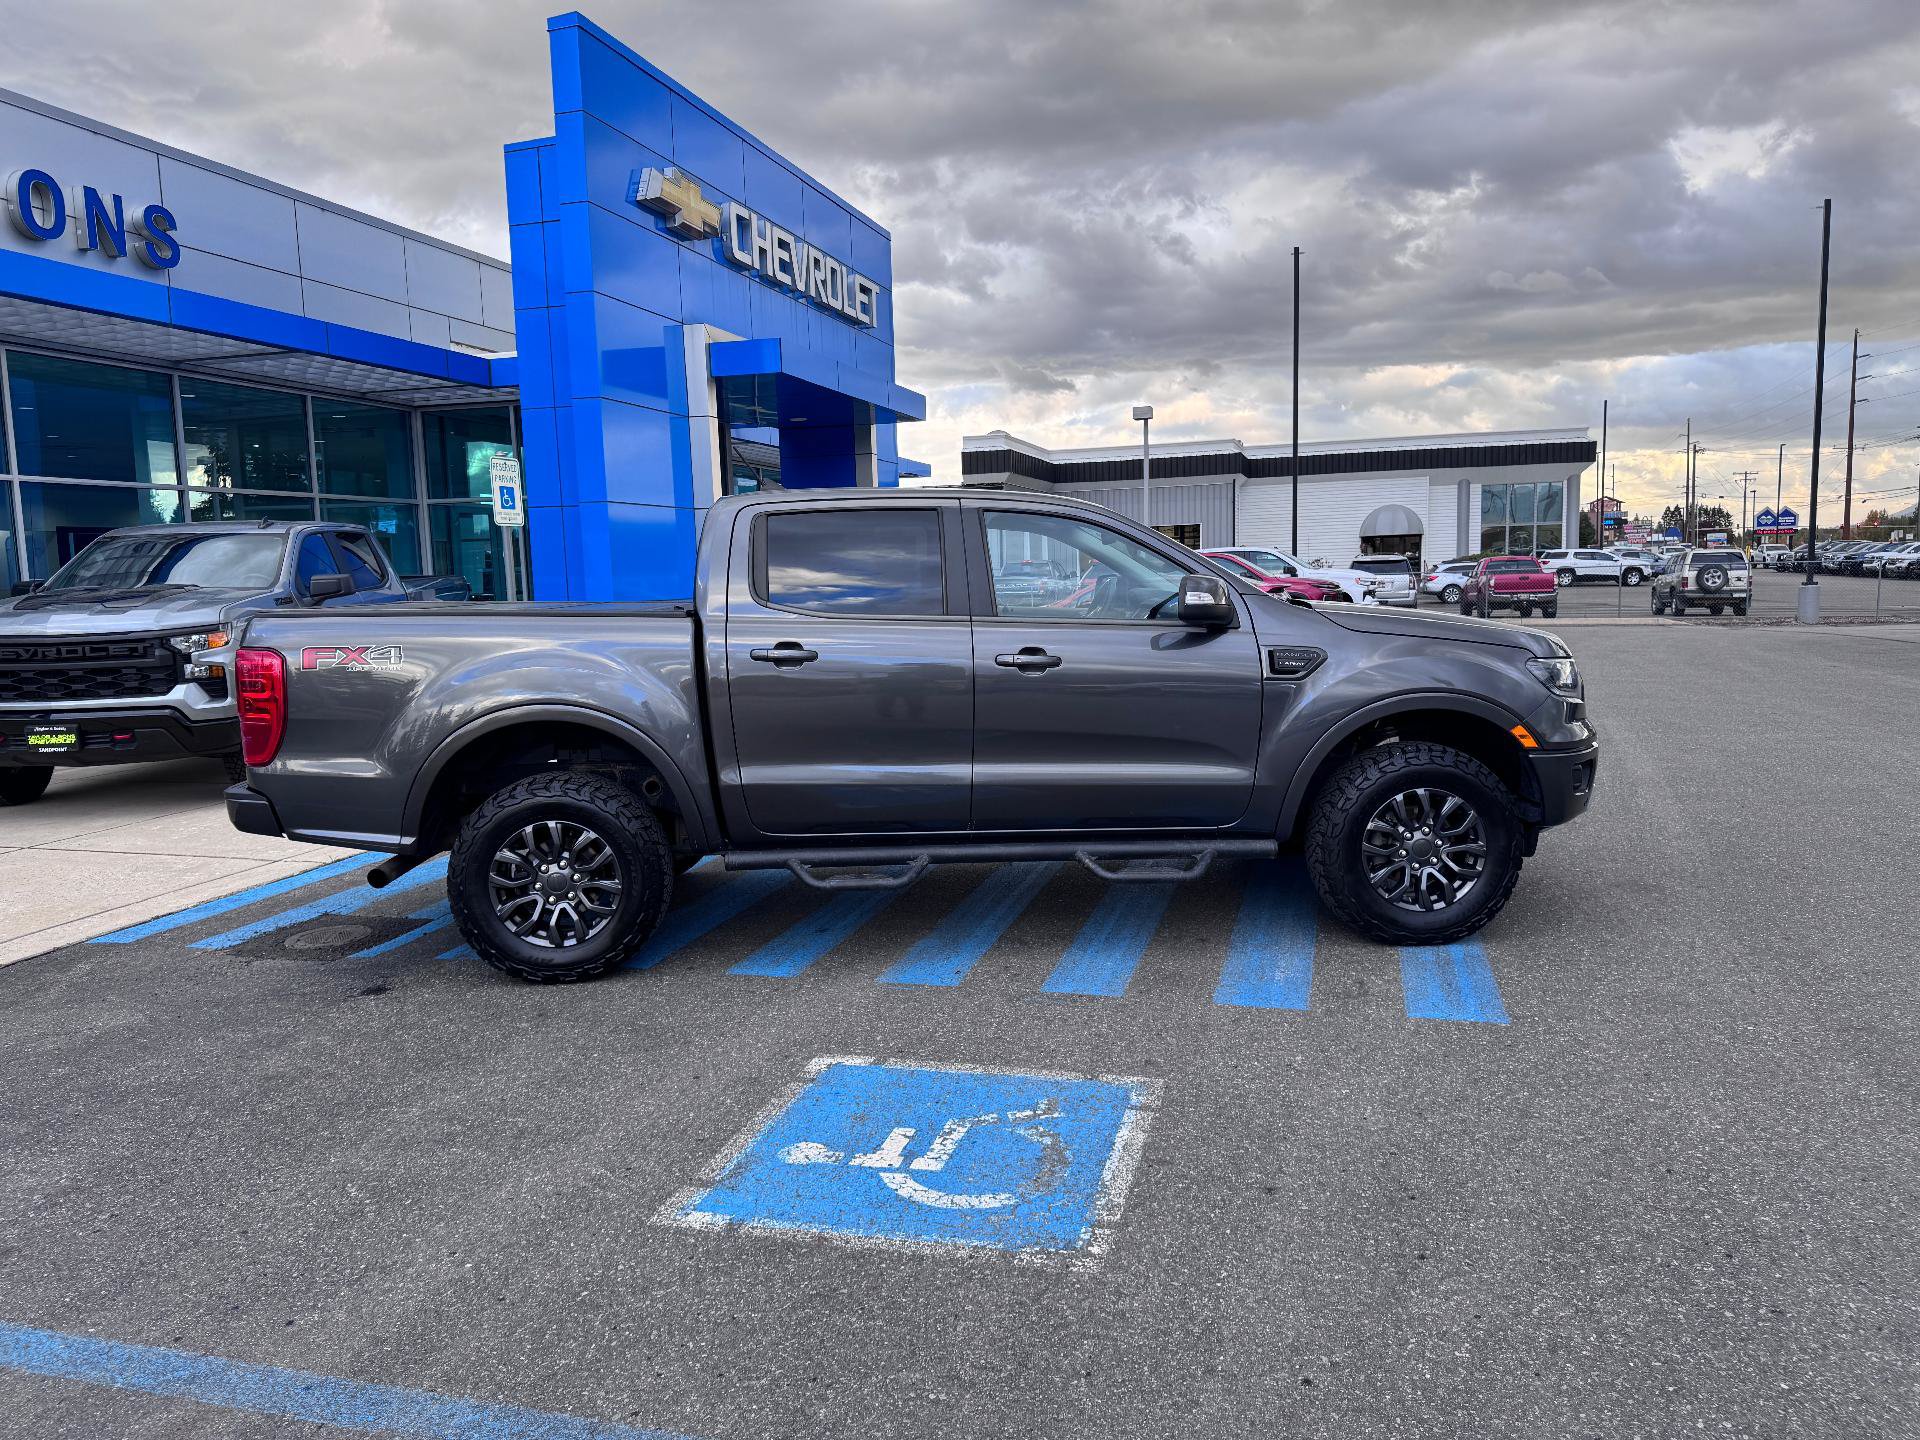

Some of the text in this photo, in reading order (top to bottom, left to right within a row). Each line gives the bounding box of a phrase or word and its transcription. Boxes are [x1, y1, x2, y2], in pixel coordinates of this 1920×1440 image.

[14, 168, 181, 269] ONS
[726, 201, 879, 328] CHEVROLET
[492, 462, 517, 473] RESERVED
[494, 474, 517, 485] PARKING
[301, 645, 403, 671] FX4
